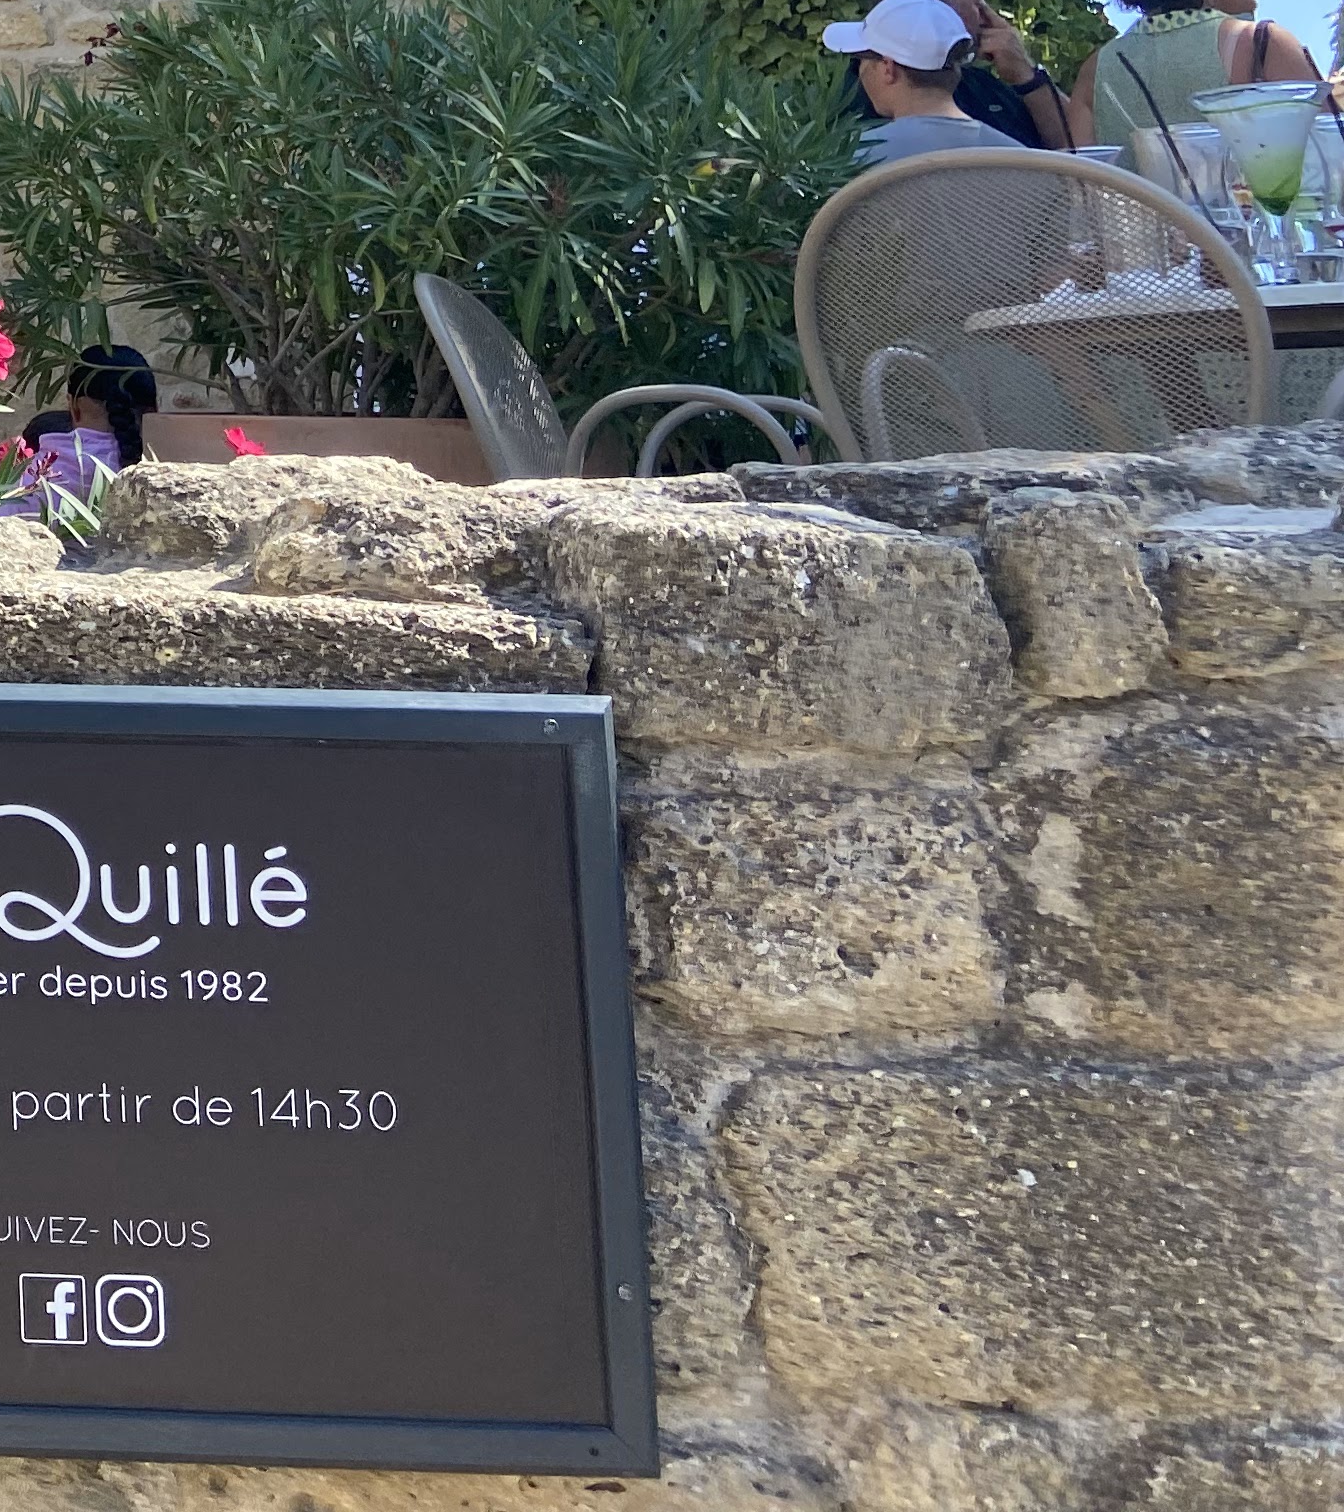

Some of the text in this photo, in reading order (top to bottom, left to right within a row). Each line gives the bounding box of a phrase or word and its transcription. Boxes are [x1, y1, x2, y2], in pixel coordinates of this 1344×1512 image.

[38, 963, 169, 1006] depuis
[180, 968, 270, 1004] 1982
[10, 1081, 153, 1132] partir
[171, 1084, 234, 1127] de
[249, 1086, 398, 1132] 14h30
